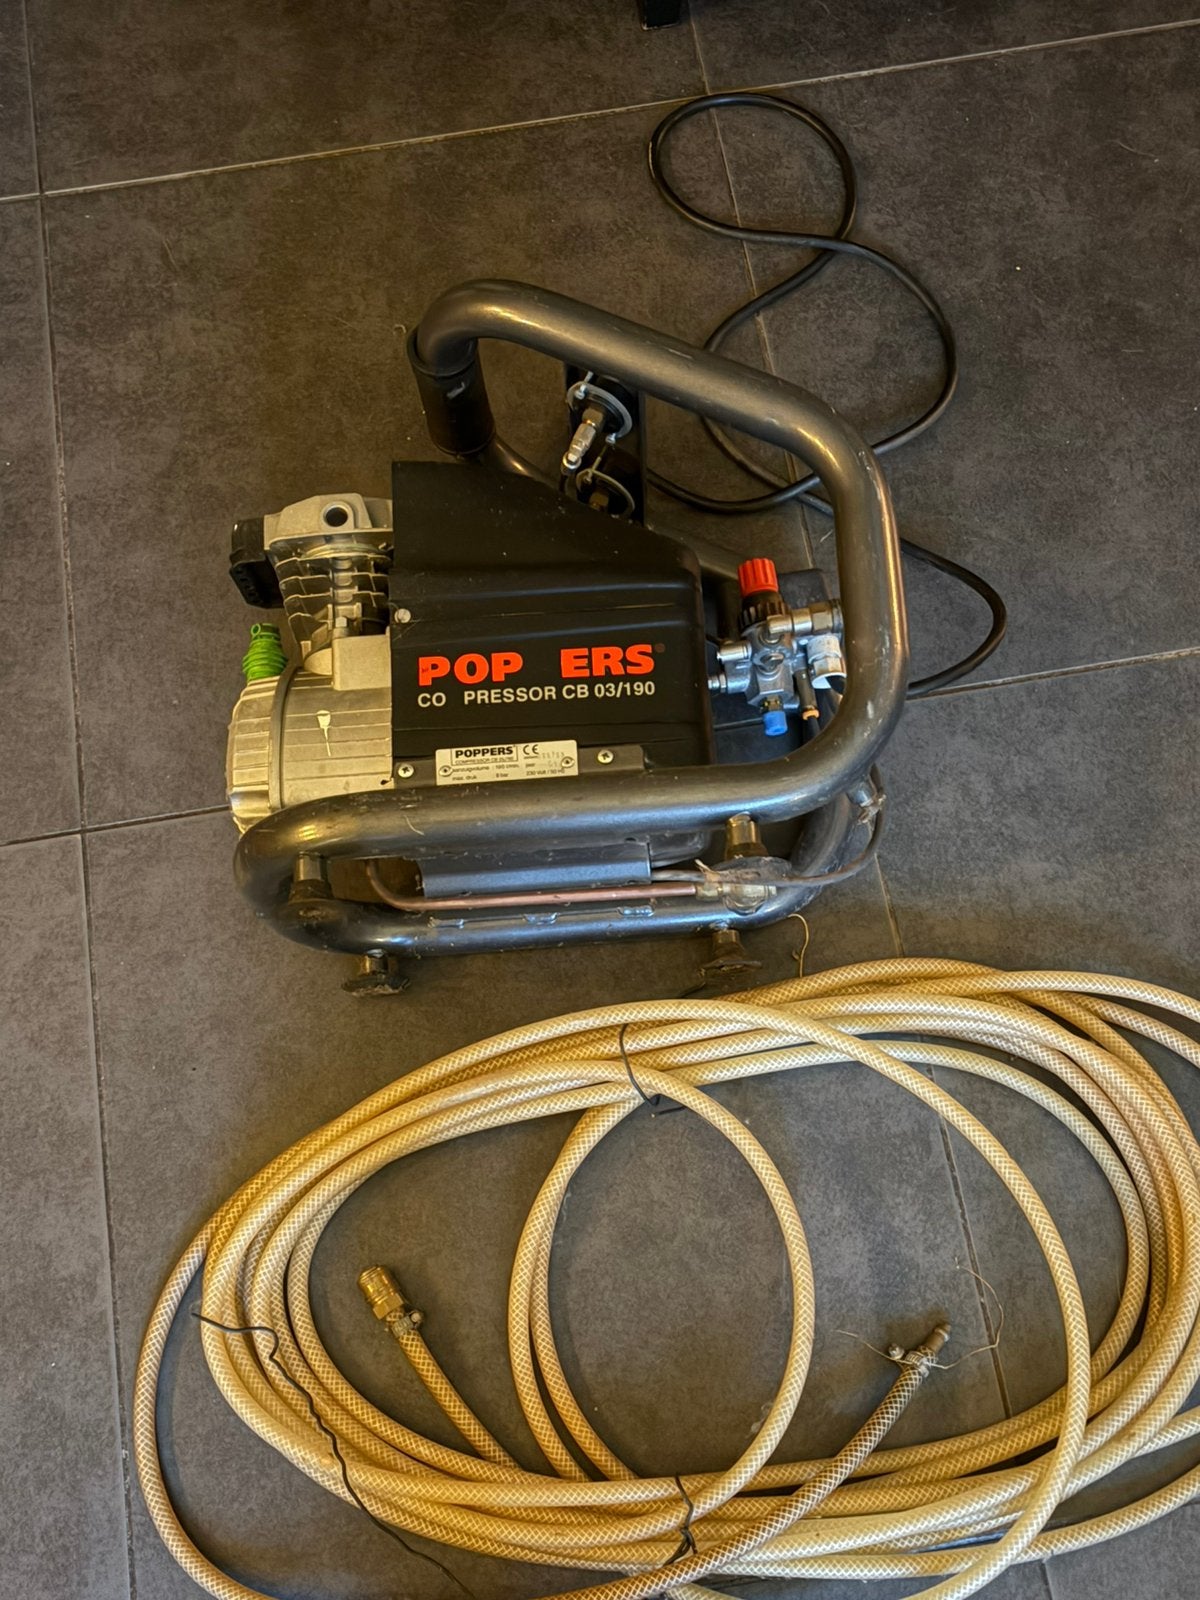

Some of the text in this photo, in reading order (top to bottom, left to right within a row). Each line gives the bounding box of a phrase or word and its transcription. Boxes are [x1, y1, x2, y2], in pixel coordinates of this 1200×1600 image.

[562, 683, 589, 700] CB
[594, 681, 656, 699] 03/190
[455, 745, 513, 758] POPPERS
